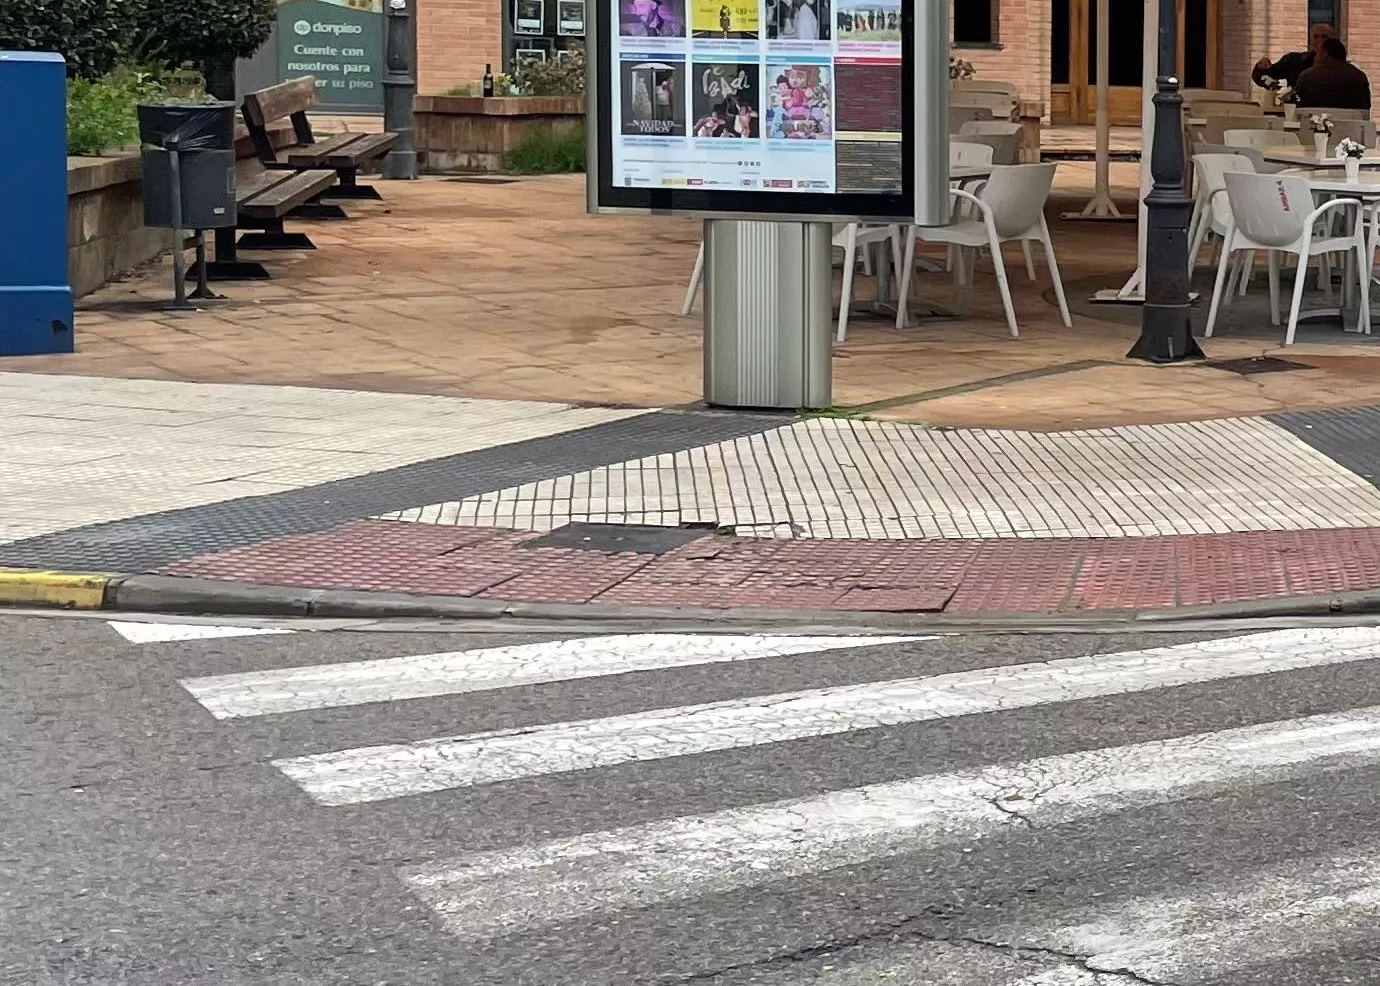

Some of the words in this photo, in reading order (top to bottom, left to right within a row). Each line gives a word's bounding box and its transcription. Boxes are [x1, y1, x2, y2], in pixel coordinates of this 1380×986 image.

[312, 21, 362, 36] donpiso
[293, 44, 338, 56] Cuente
[342, 47, 364, 56] con
[287, 62, 339, 72] nosotros
[343, 64, 371, 75] para
